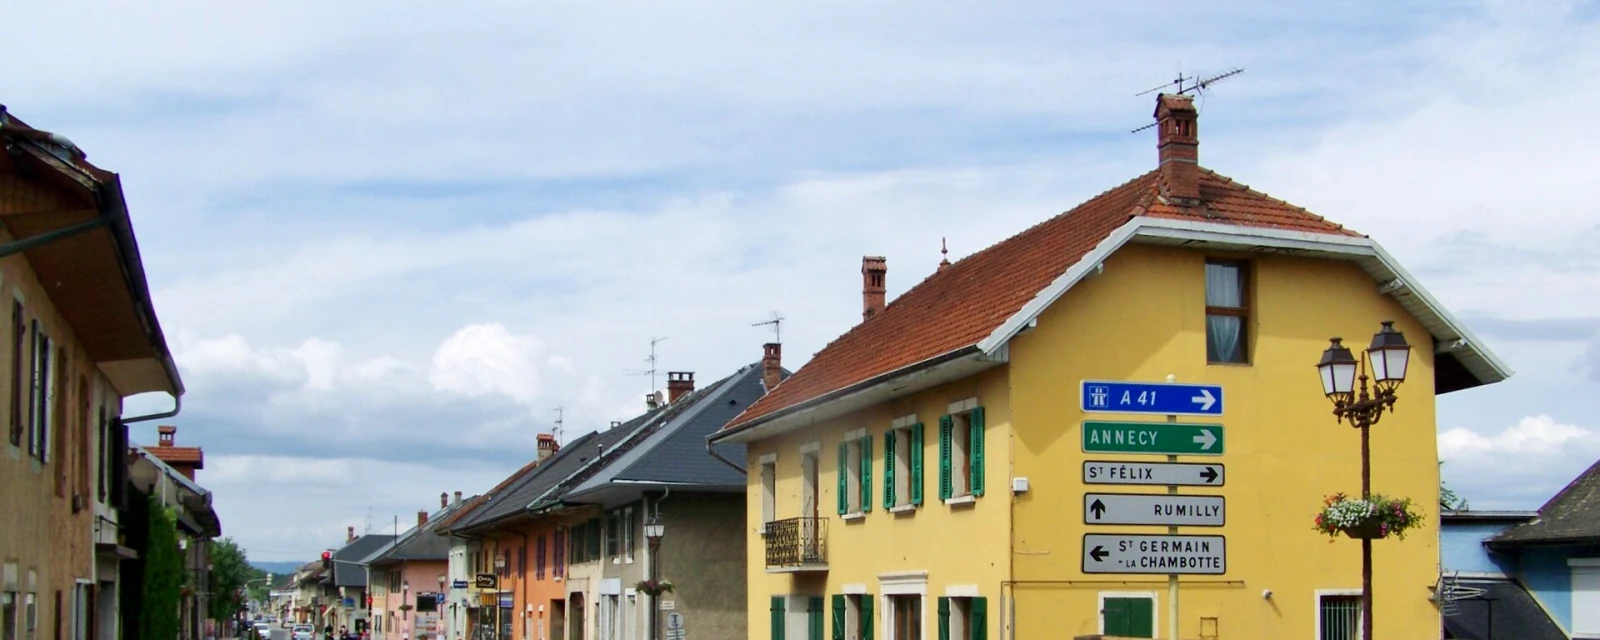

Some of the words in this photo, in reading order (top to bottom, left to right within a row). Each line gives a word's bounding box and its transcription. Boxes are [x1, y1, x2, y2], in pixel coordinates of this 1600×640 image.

[1120, 390, 1131, 405] A
[1137, 391, 1156, 406] 41
[1090, 429, 1158, 446] ANNECY
[1110, 465, 1153, 480] FÉLIX
[1154, 504, 1220, 517] RUMILLY
[1140, 541, 1210, 553] GERMAIN
[1140, 556, 1220, 568] CHAMBOTTE
